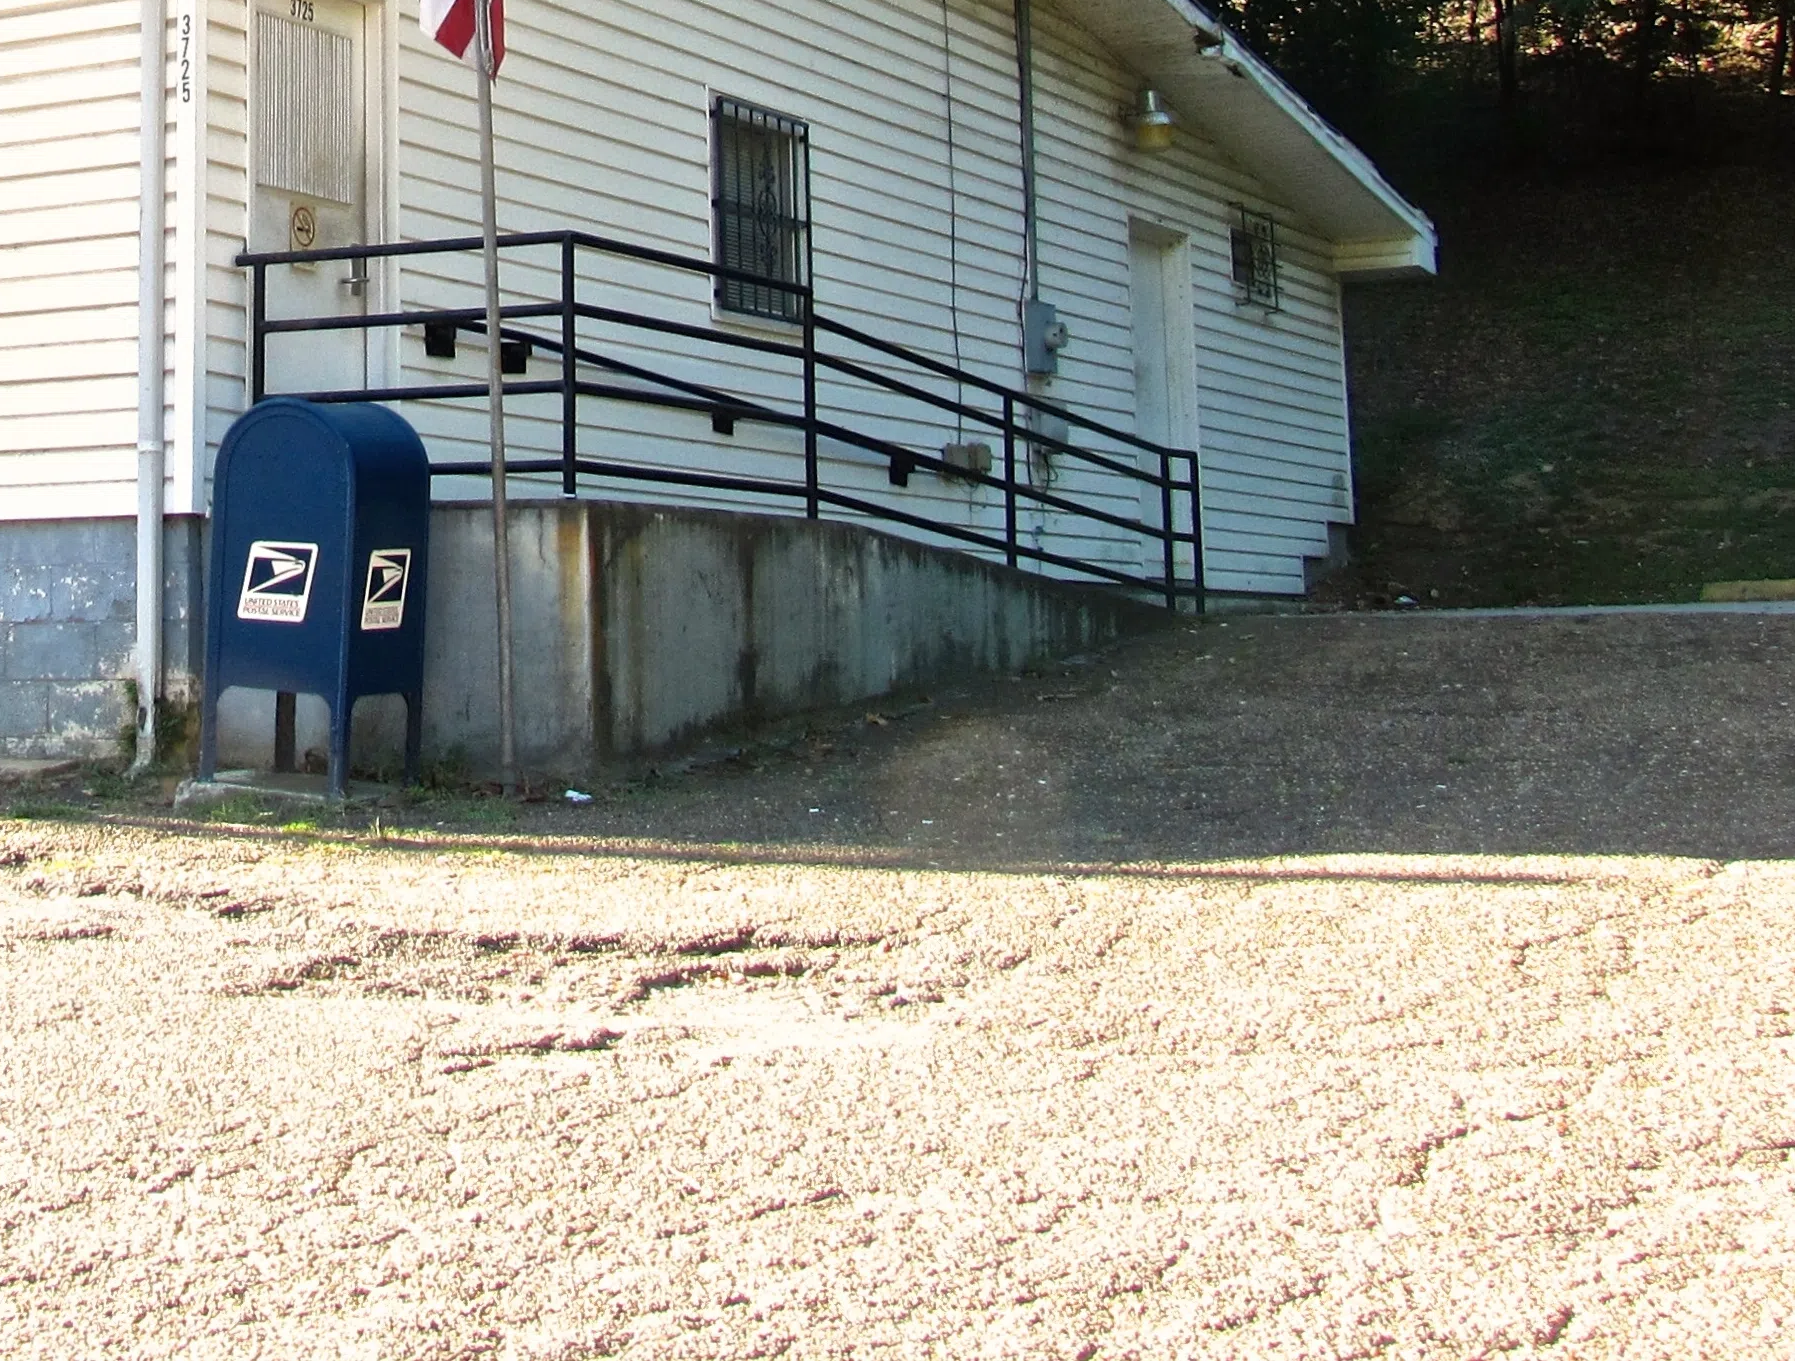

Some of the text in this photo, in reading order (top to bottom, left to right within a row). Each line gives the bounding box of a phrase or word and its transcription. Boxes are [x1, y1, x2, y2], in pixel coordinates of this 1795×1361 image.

[181, 14, 191, 103] 3725
[245, 597, 299, 608] UNITED STATES
[272, 608, 300, 617] SERVICE
